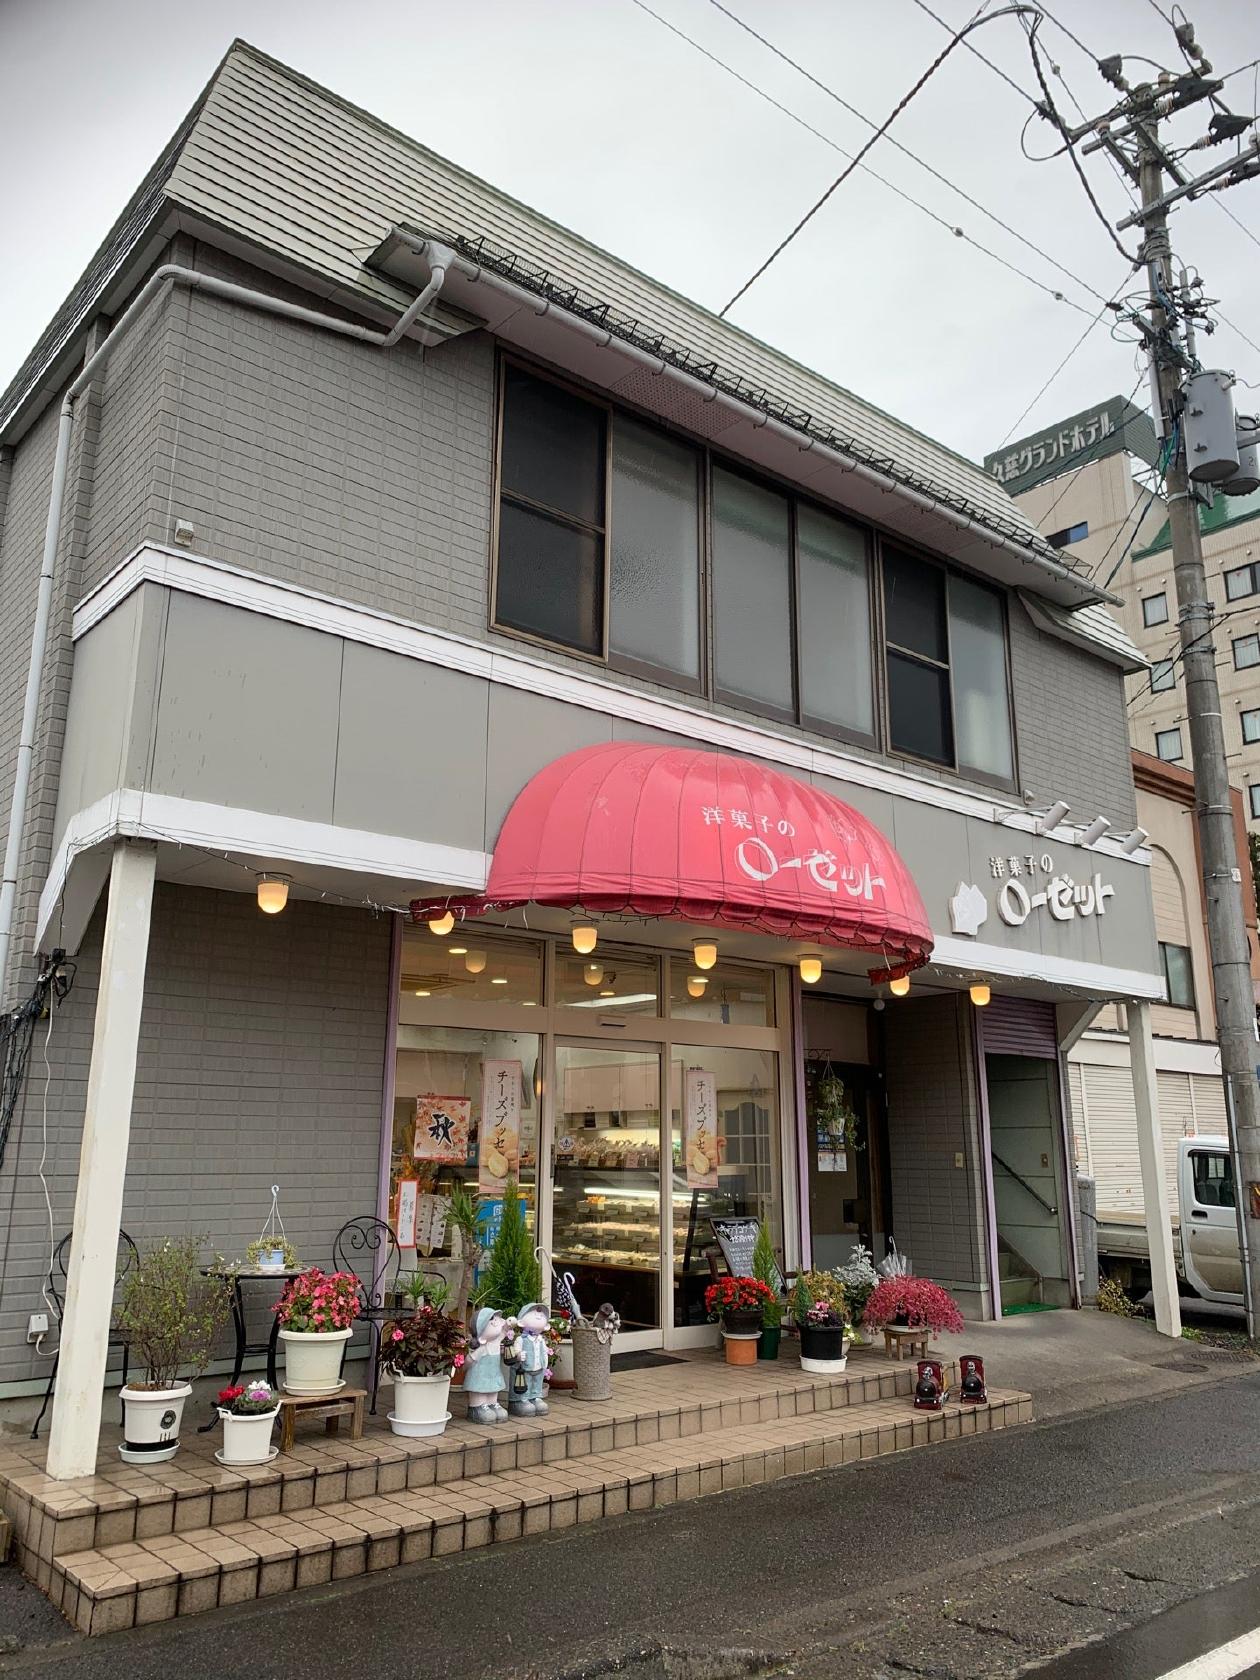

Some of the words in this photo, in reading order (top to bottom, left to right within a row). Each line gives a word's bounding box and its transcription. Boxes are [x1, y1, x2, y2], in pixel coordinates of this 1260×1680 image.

[702, 806, 795, 837] 洋菓子の
[735, 837, 886, 900] ローゼット
[989, 853, 1053, 878] 洋菓子の
[997, 873, 1115, 926] ローゼット
[428, 1113, 455, 1147] 秋
